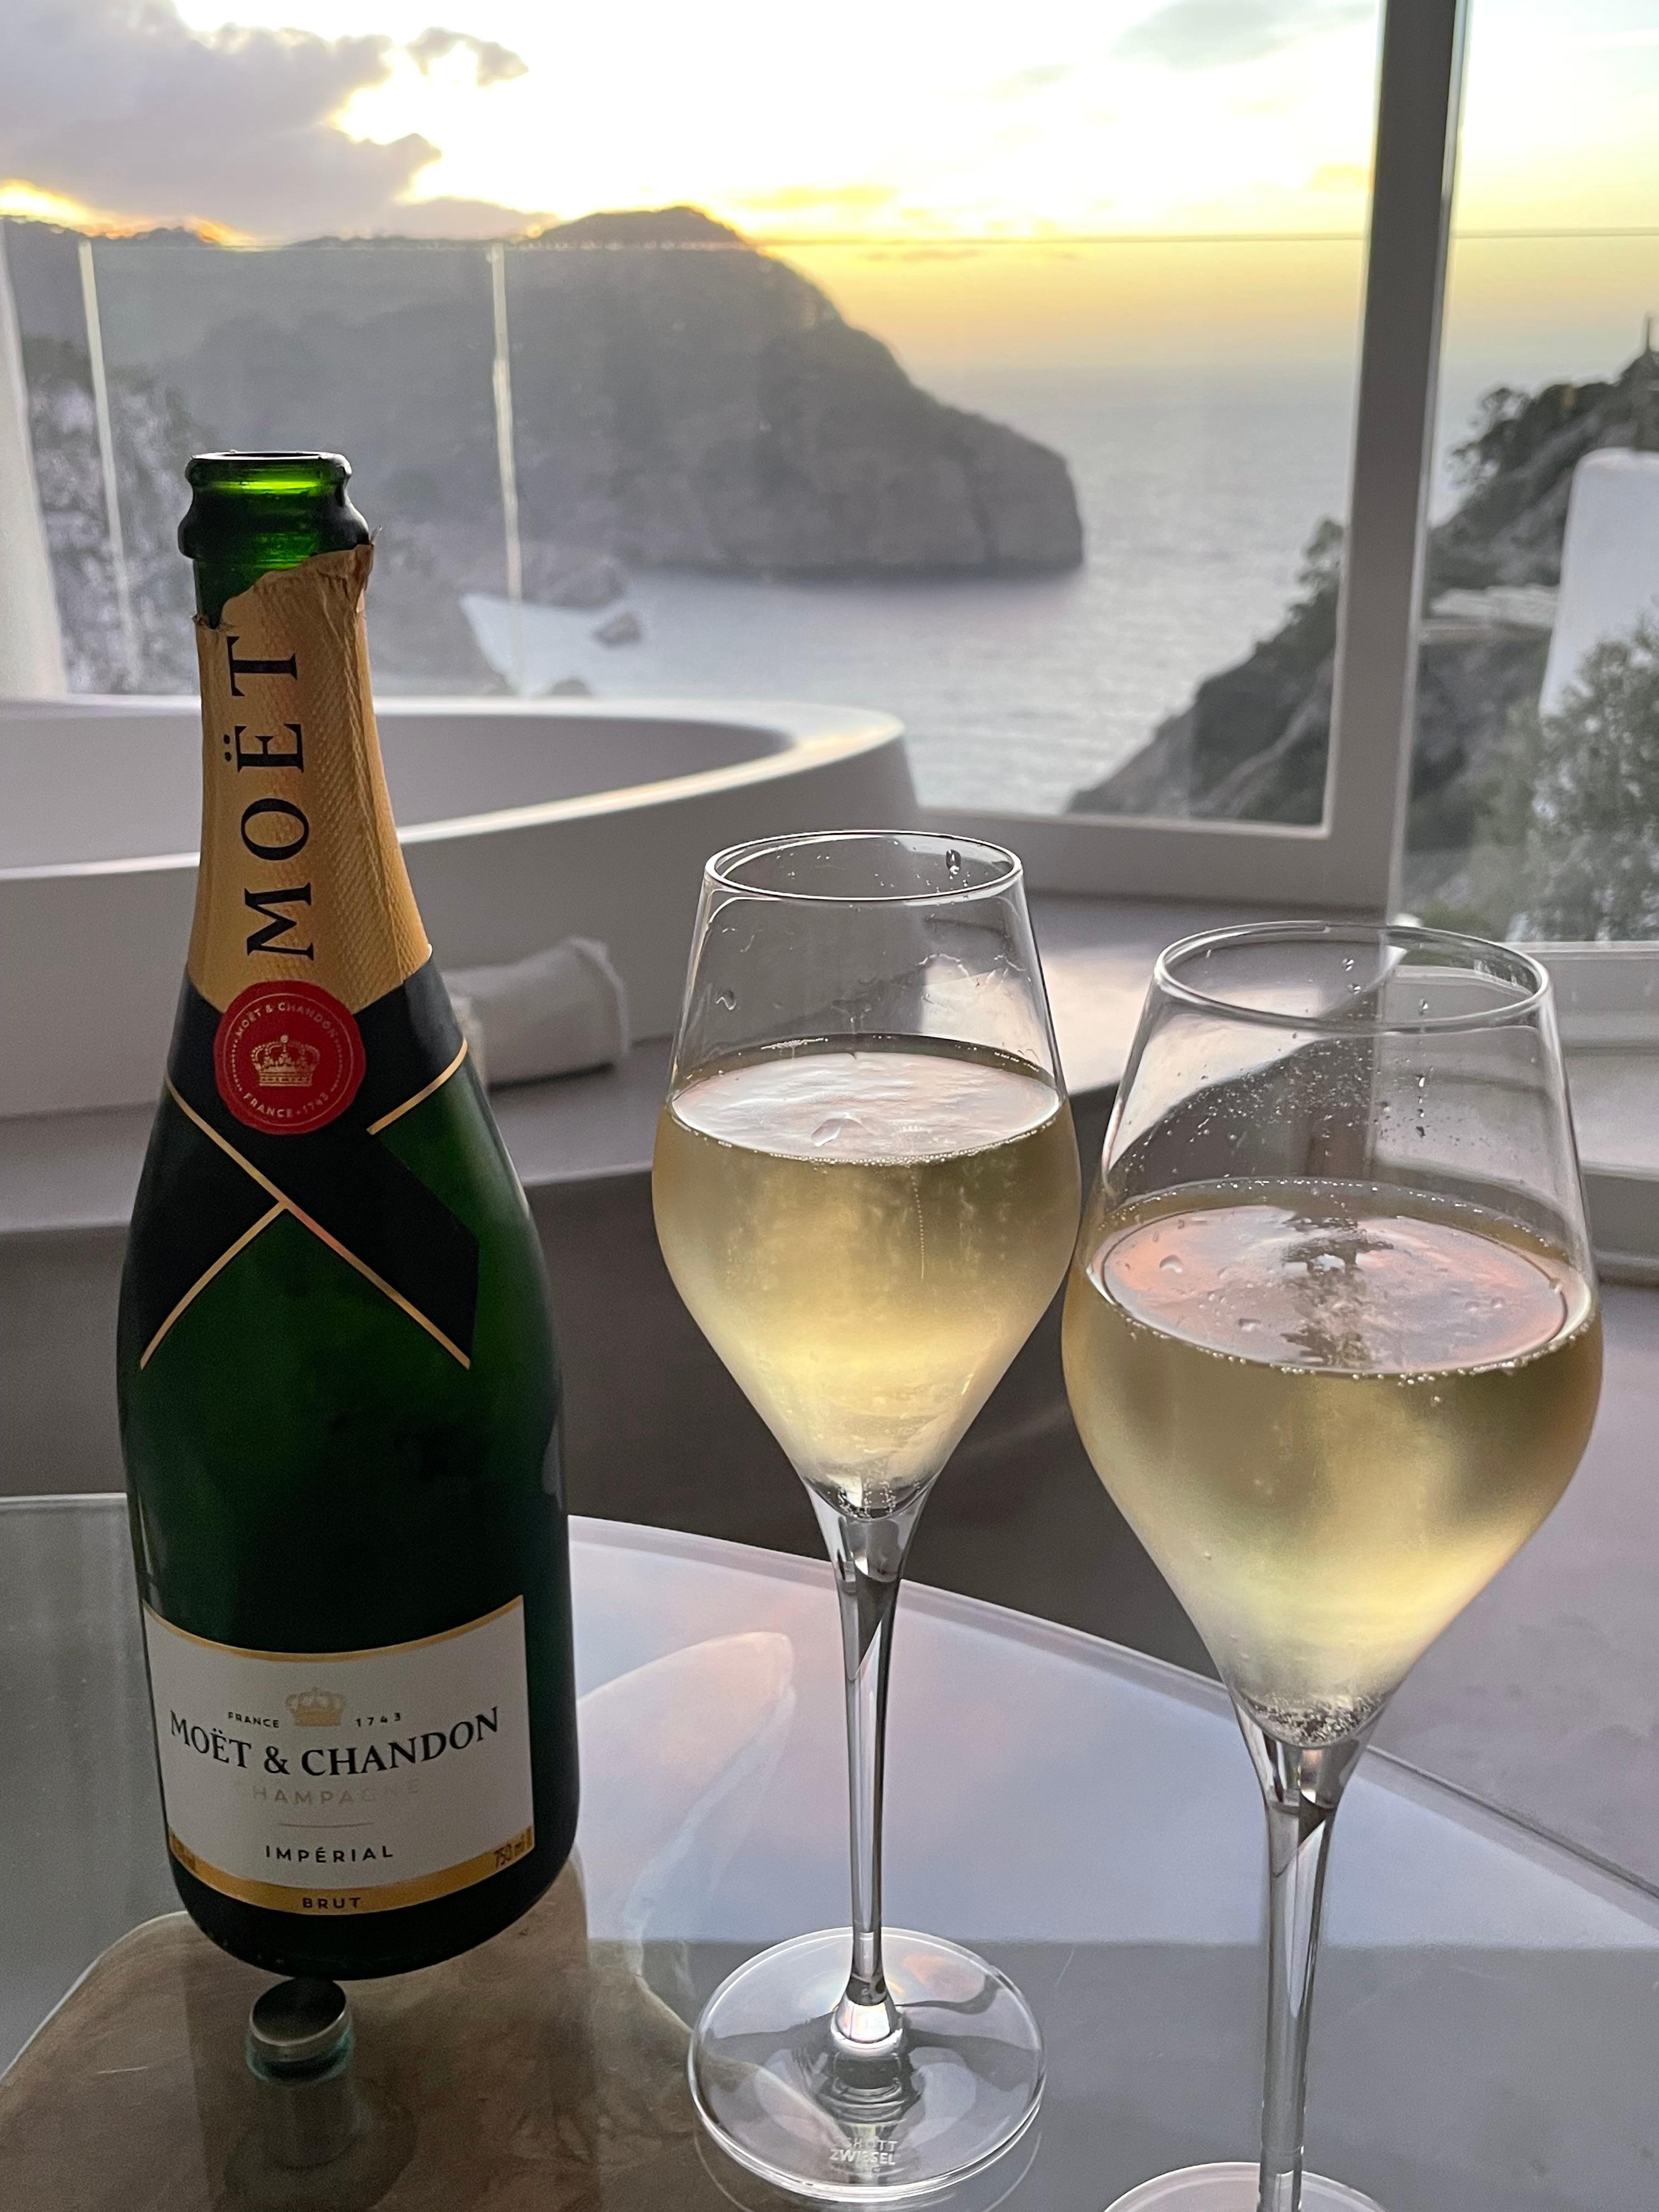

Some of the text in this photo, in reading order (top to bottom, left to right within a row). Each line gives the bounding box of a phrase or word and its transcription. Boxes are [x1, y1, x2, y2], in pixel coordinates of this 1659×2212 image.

[223, 636, 314, 961] MOËT
[278, 1001, 338, 1037] CHANDON
[243, 1092, 294, 1118] FRANCE
[228, 1712, 400, 1728] FRANCE 1743
[170, 1706, 498, 1776] MOËT & CHANDON
[266, 1845, 393, 1863] IMPÉRIAL
[303, 1897, 360, 1909] BRUT
